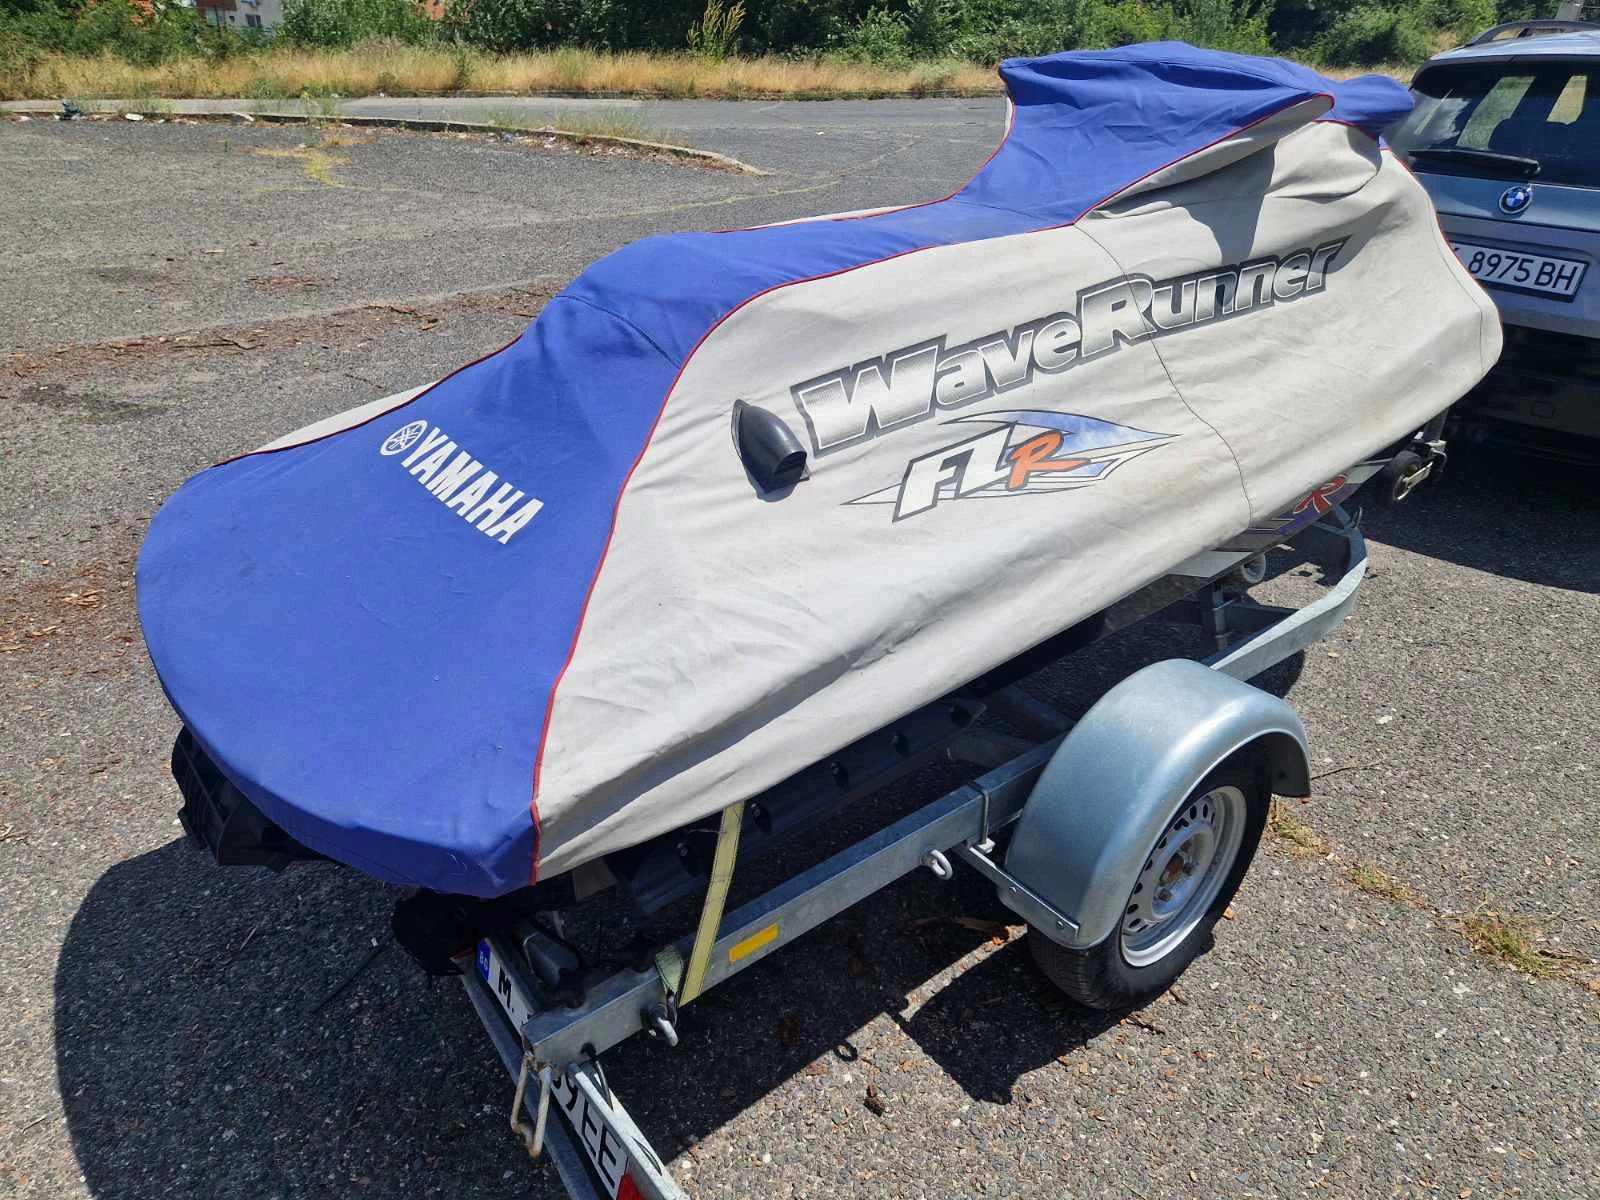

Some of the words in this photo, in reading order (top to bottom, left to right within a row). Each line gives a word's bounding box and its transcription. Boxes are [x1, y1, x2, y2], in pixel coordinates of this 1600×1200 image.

[1468, 251, 1534, 283] 8975
[1534, 262, 1578, 291] BH
[790, 234, 1352, 458] WaveRunner
[401, 427, 544, 545] YAMAHA
[893, 421, 1090, 523] FZR
